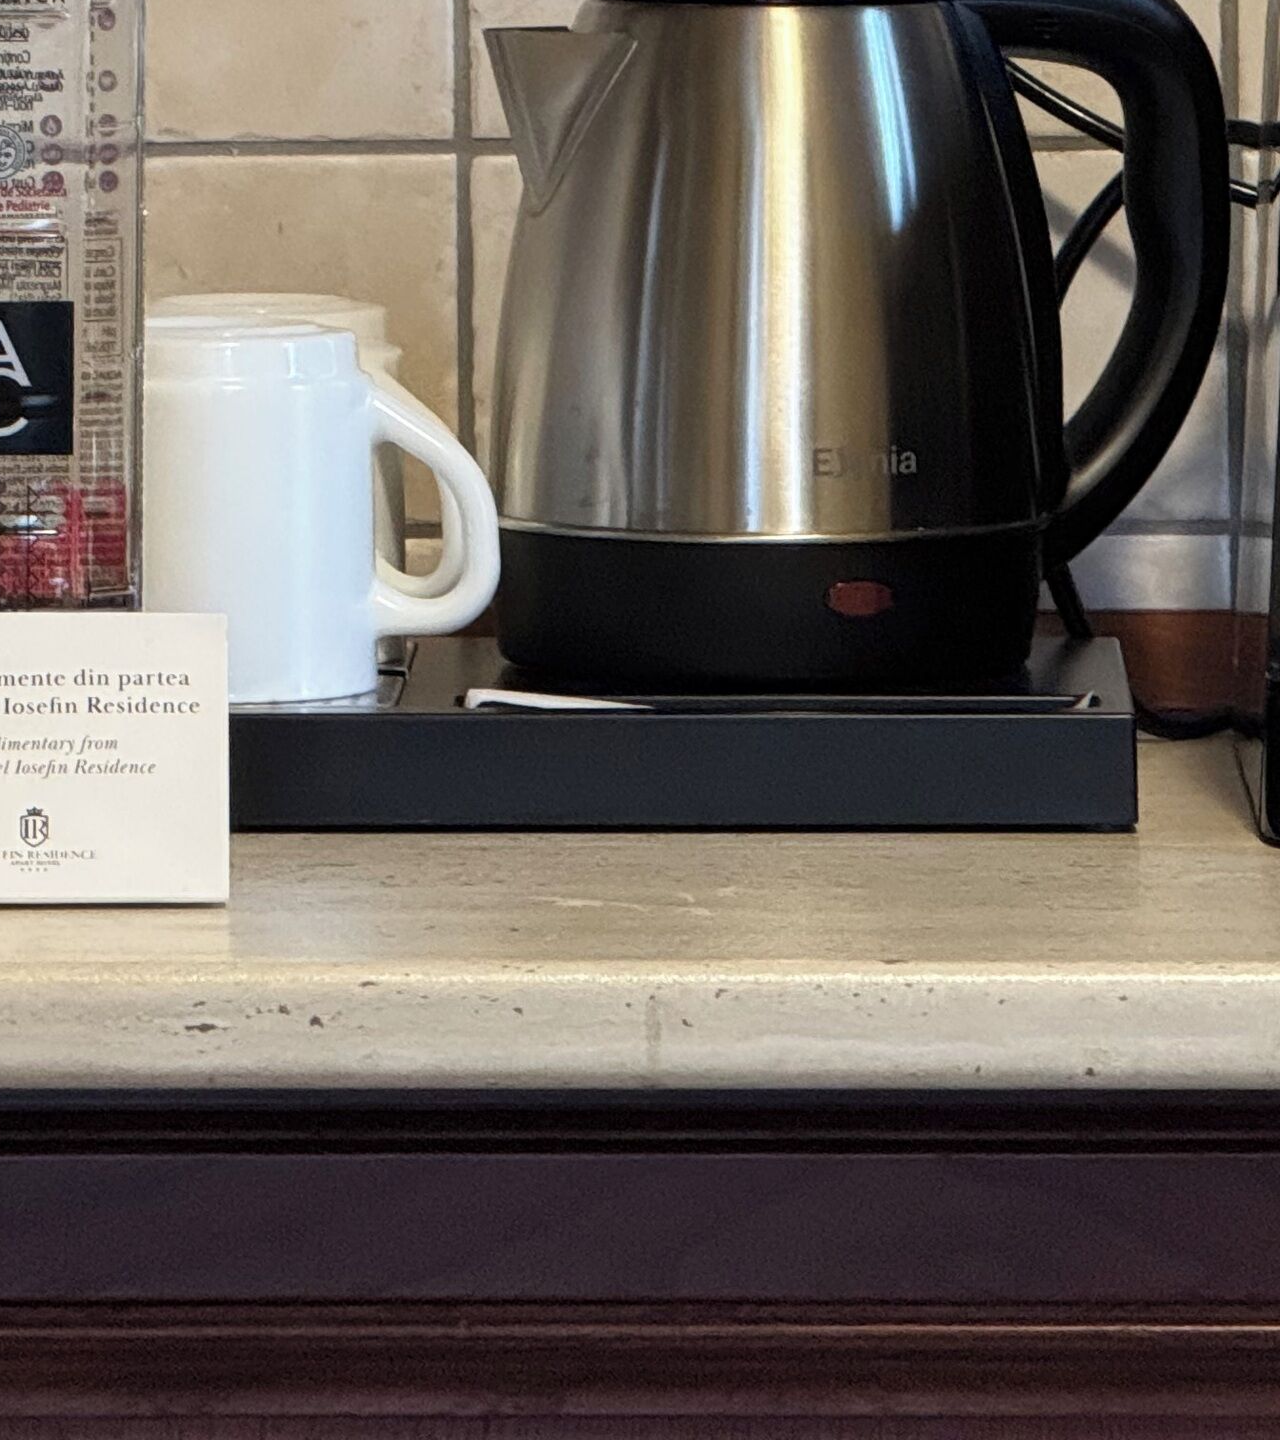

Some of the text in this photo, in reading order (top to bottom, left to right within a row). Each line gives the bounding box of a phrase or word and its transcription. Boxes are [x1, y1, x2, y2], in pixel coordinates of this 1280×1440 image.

[73, 668, 110, 686] din
[118, 671, 190, 692] partea
[3, 696, 78, 715] Iosefin
[86, 696, 201, 714] Residence
[76, 735, 119, 756] from
[14, 759, 68, 780] Iosefin
[74, 758, 157, 775] Residence
